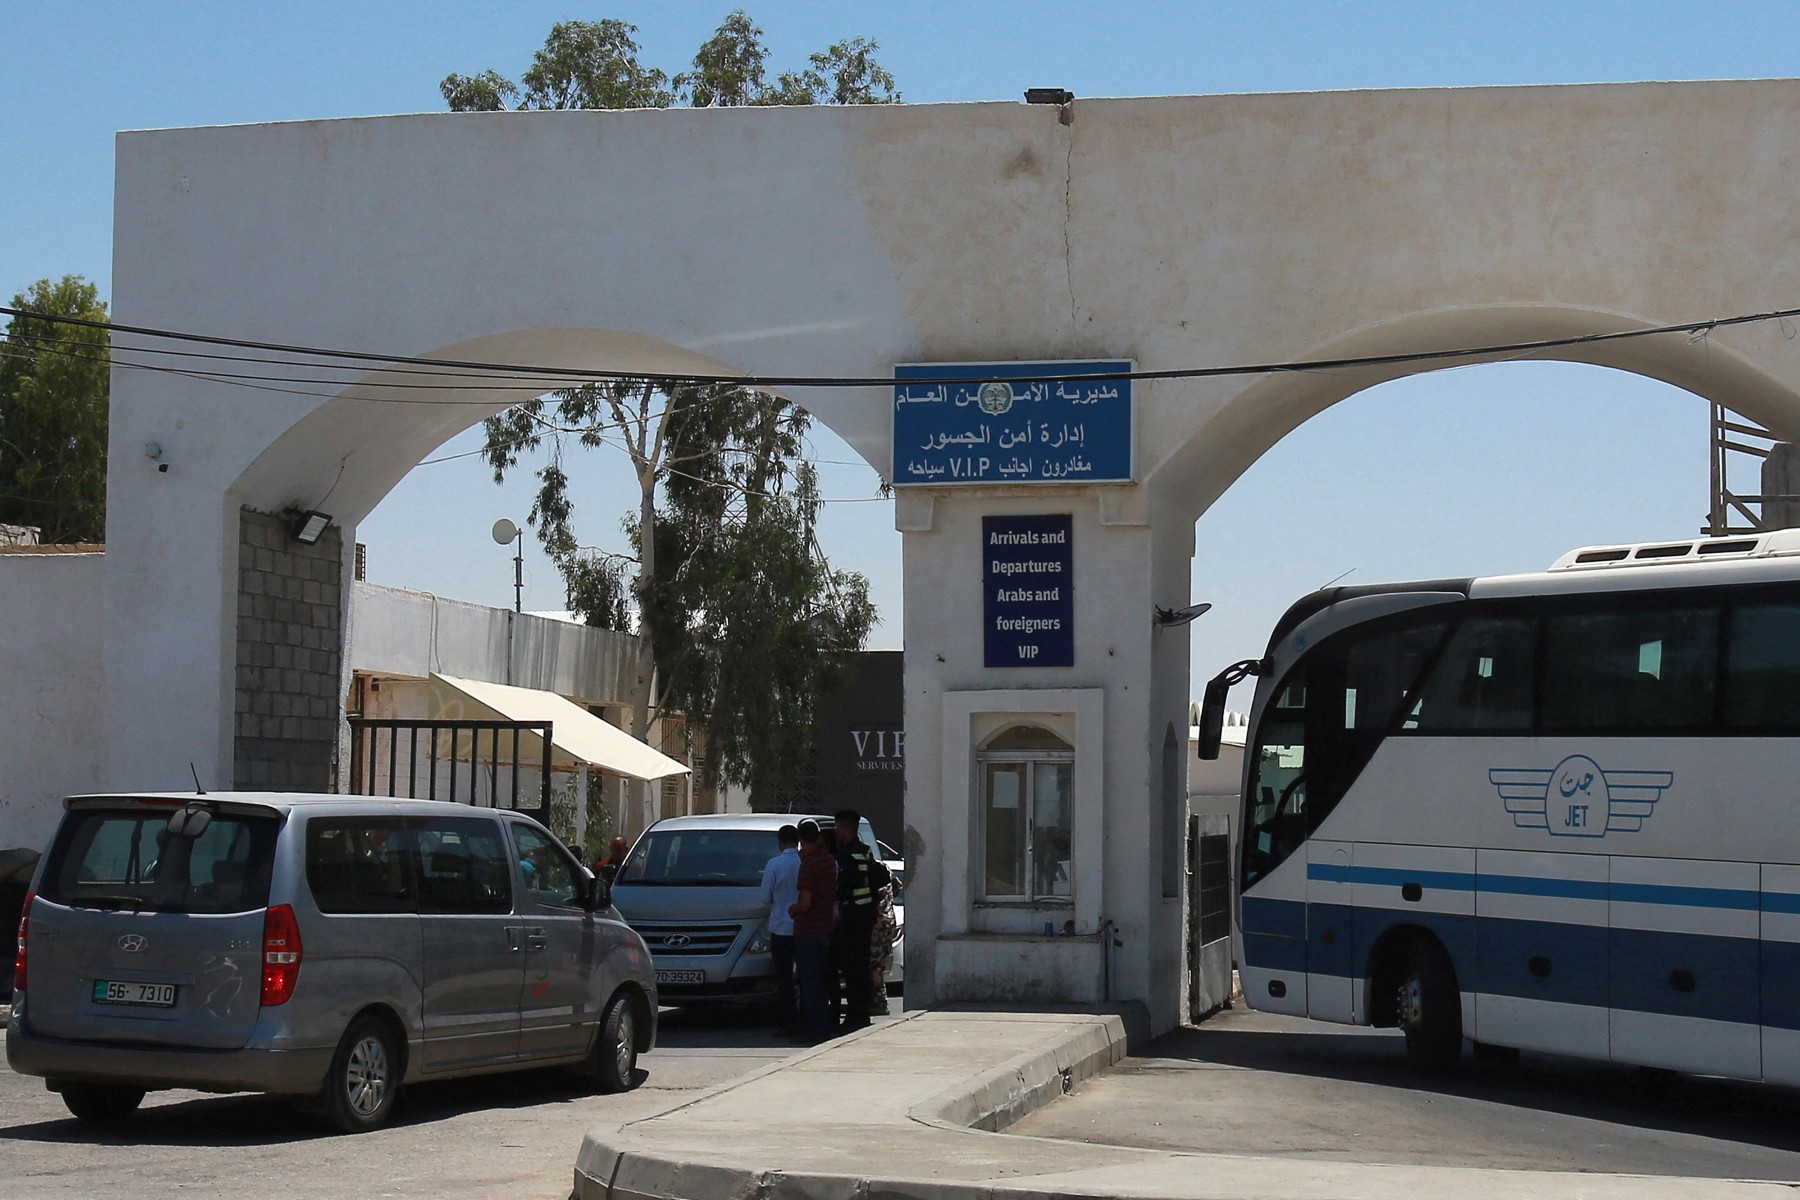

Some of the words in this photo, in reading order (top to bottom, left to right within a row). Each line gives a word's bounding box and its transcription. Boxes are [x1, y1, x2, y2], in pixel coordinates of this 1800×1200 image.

[896, 385, 947, 412] العام
[1055, 381, 1119, 405] مديرية
[920, 423, 991, 450] الجسور
[998, 420, 1032, 449] أمن
[1040, 422, 1085, 448] إدارة
[949, 457, 990, 478] V.I.P
[1041, 454, 1092, 478] مغادرون
[990, 531, 1039, 545] Arrivals
[1041, 530, 1065, 544] and
[992, 560, 1062, 576] Departures
[997, 588, 1033, 602] Arabs
[1035, 587, 1059, 601] and
[996, 616, 1061, 634] foreigners
[1018, 645, 1039, 659] VIP
[850, 730, 905, 758] VIP
[856, 761, 903, 770] SERVICES
[1564, 805, 1589, 827] JET
